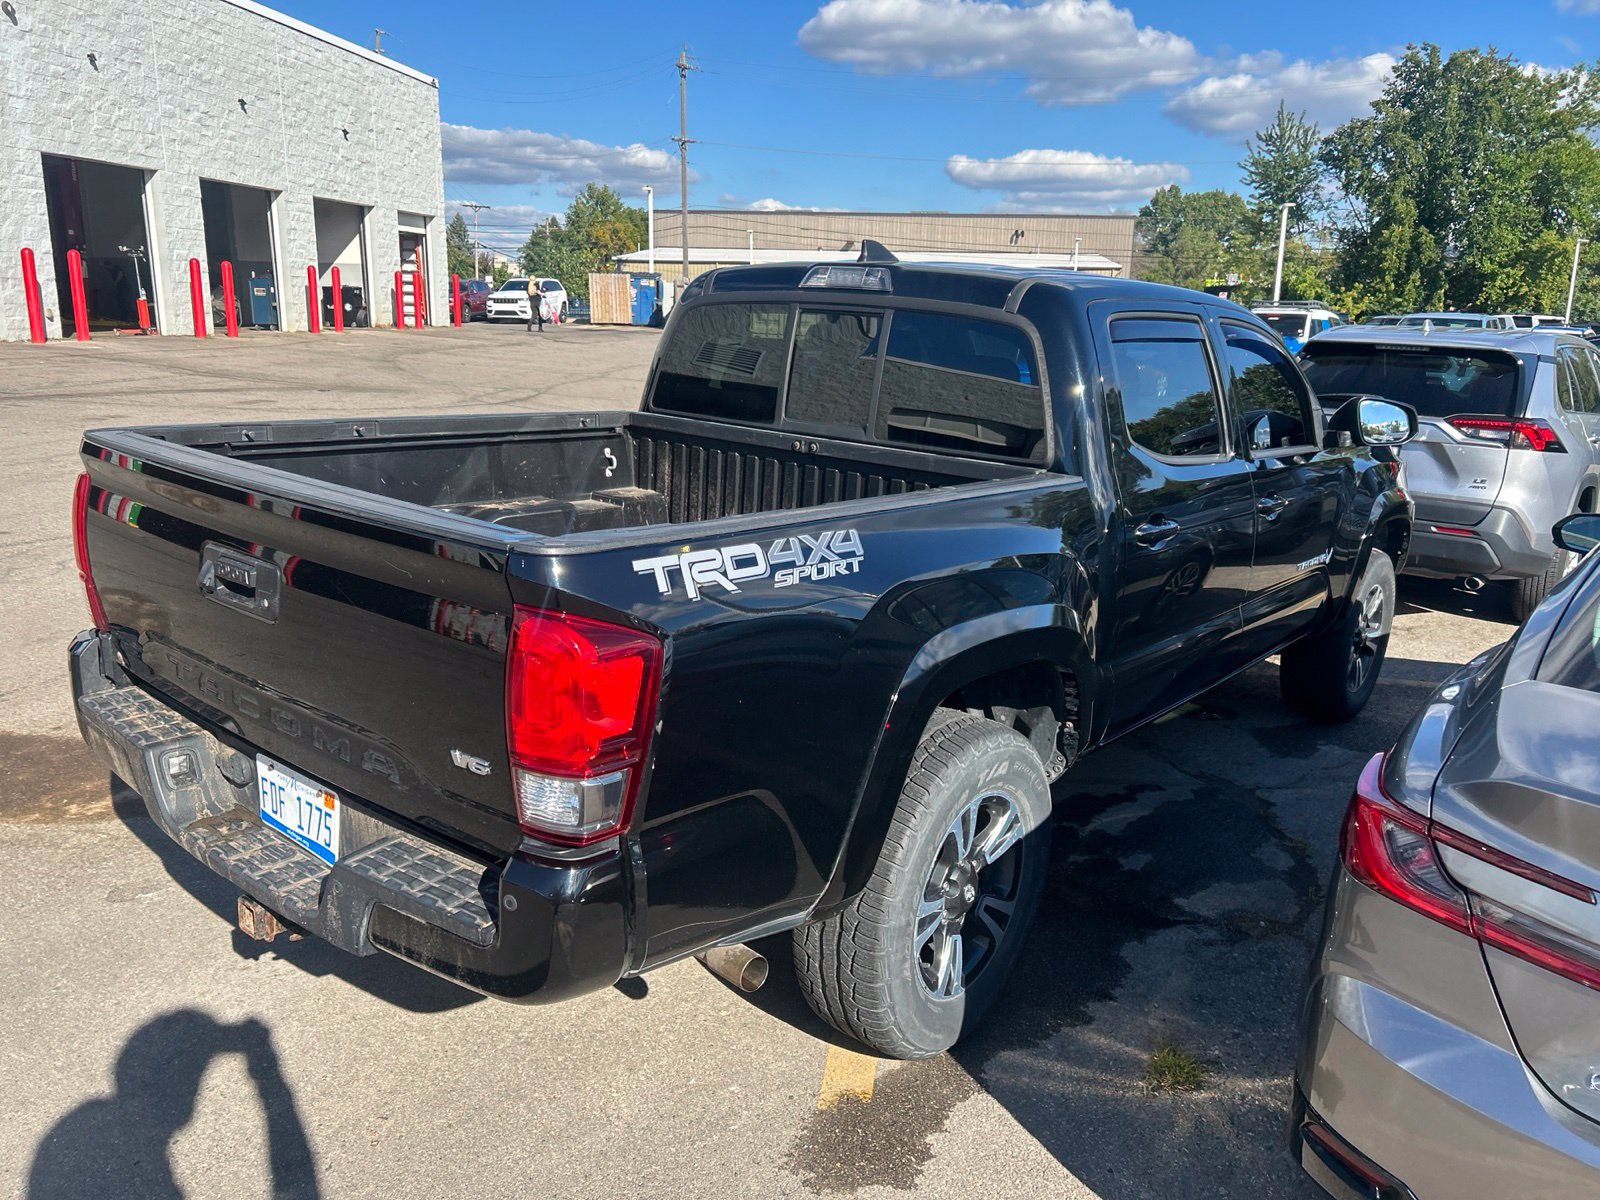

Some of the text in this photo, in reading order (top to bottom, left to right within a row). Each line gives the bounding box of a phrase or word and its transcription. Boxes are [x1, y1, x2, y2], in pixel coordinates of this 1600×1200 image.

[632, 543, 771, 601] TRD
[774, 556, 865, 588] SPORT
[166, 652, 404, 786] TACOMA
[450, 749, 491, 776] V6
[261, 777, 332, 848] FDF 1775
